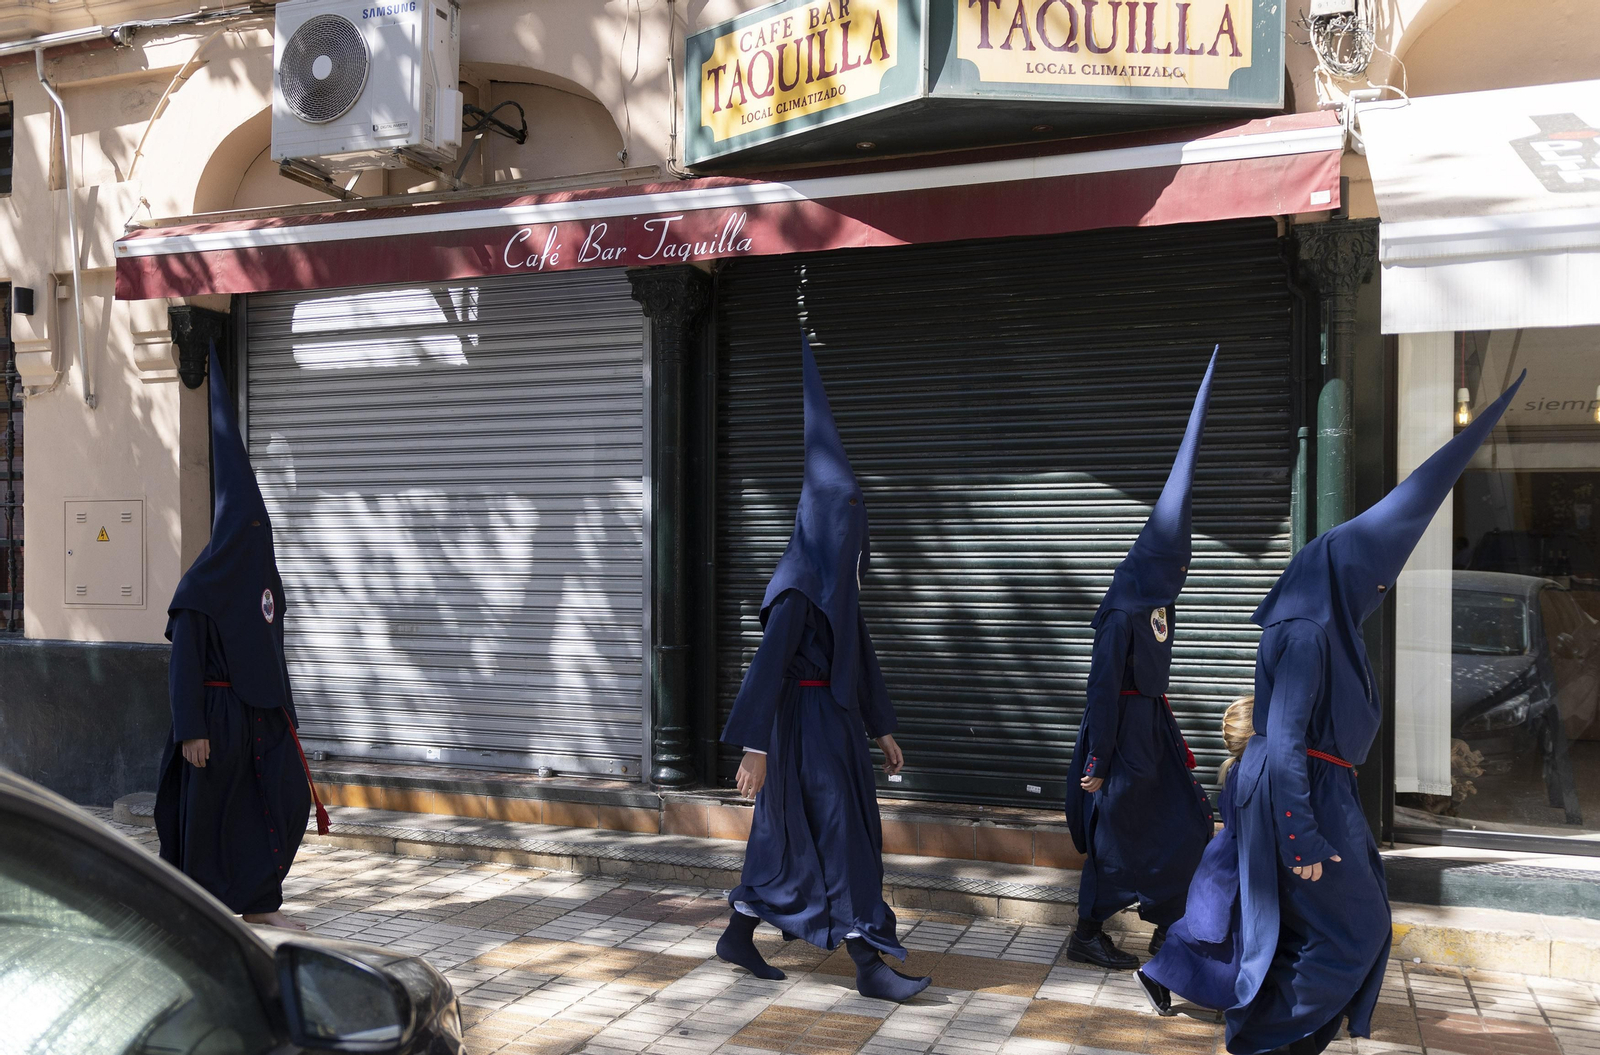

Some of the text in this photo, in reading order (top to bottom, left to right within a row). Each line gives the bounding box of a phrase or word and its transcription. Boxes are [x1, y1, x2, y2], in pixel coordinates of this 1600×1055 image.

[362, 1, 416, 20] SAMSUNG
[740, 0, 850, 52] CAFE BAR
[968, 0, 1243, 57] TAQUILLA
[707, 9, 890, 114] TAQUILLA
[1026, 62, 1076, 76] LOCAL
[741, 84, 847, 125] LOCAL CLIMATIZADO
[504, 212, 753, 271] Café Bar Taquilla
